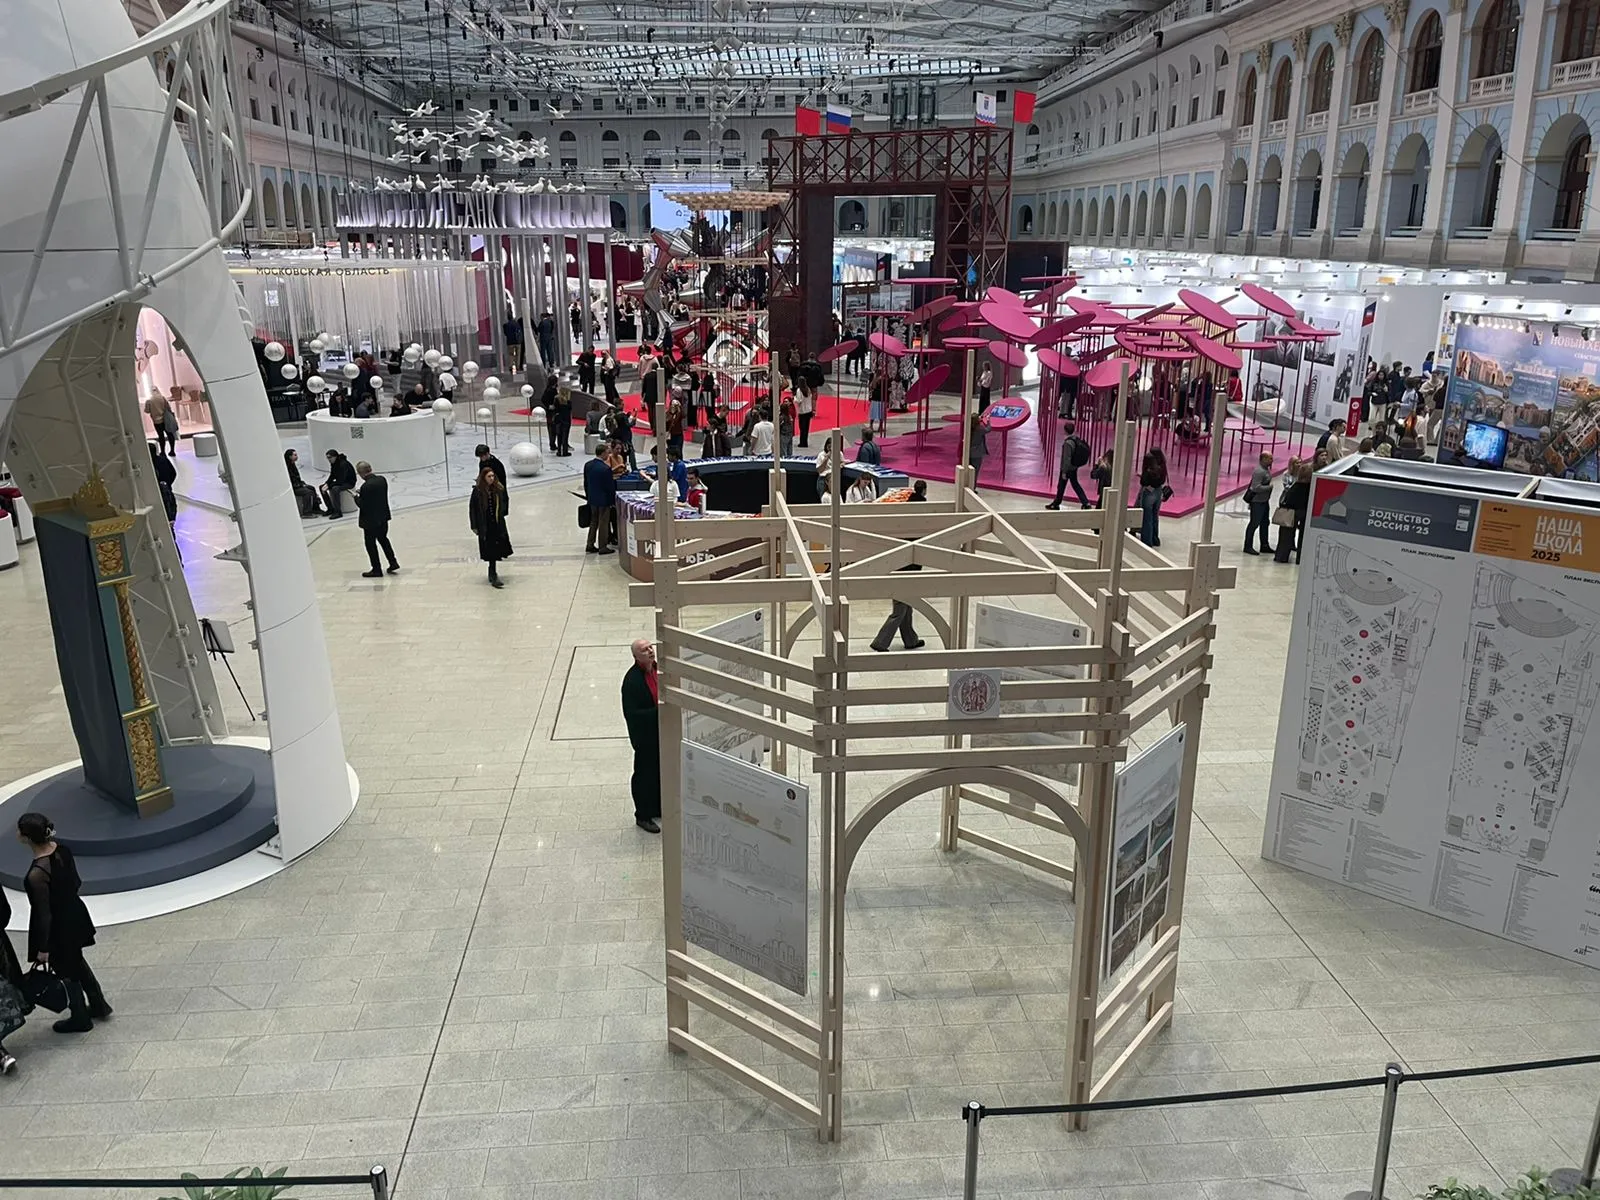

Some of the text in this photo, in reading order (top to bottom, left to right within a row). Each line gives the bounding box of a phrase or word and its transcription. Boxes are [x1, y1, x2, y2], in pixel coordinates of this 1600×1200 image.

[256, 267, 390, 277] МОСКОВСКАЯ ОБЛАСТЬ
[1368, 509, 1431, 526] ЗОДЧЕСТВО
[1367, 519, 1410, 532] РОССИЯ
[1535, 515, 1582, 537] НАША
[1533, 532, 1583, 556] ШКОЛА
[1531, 549, 1561, 562] 2025
[1564, 574, 1582, 582] ПЛАН
